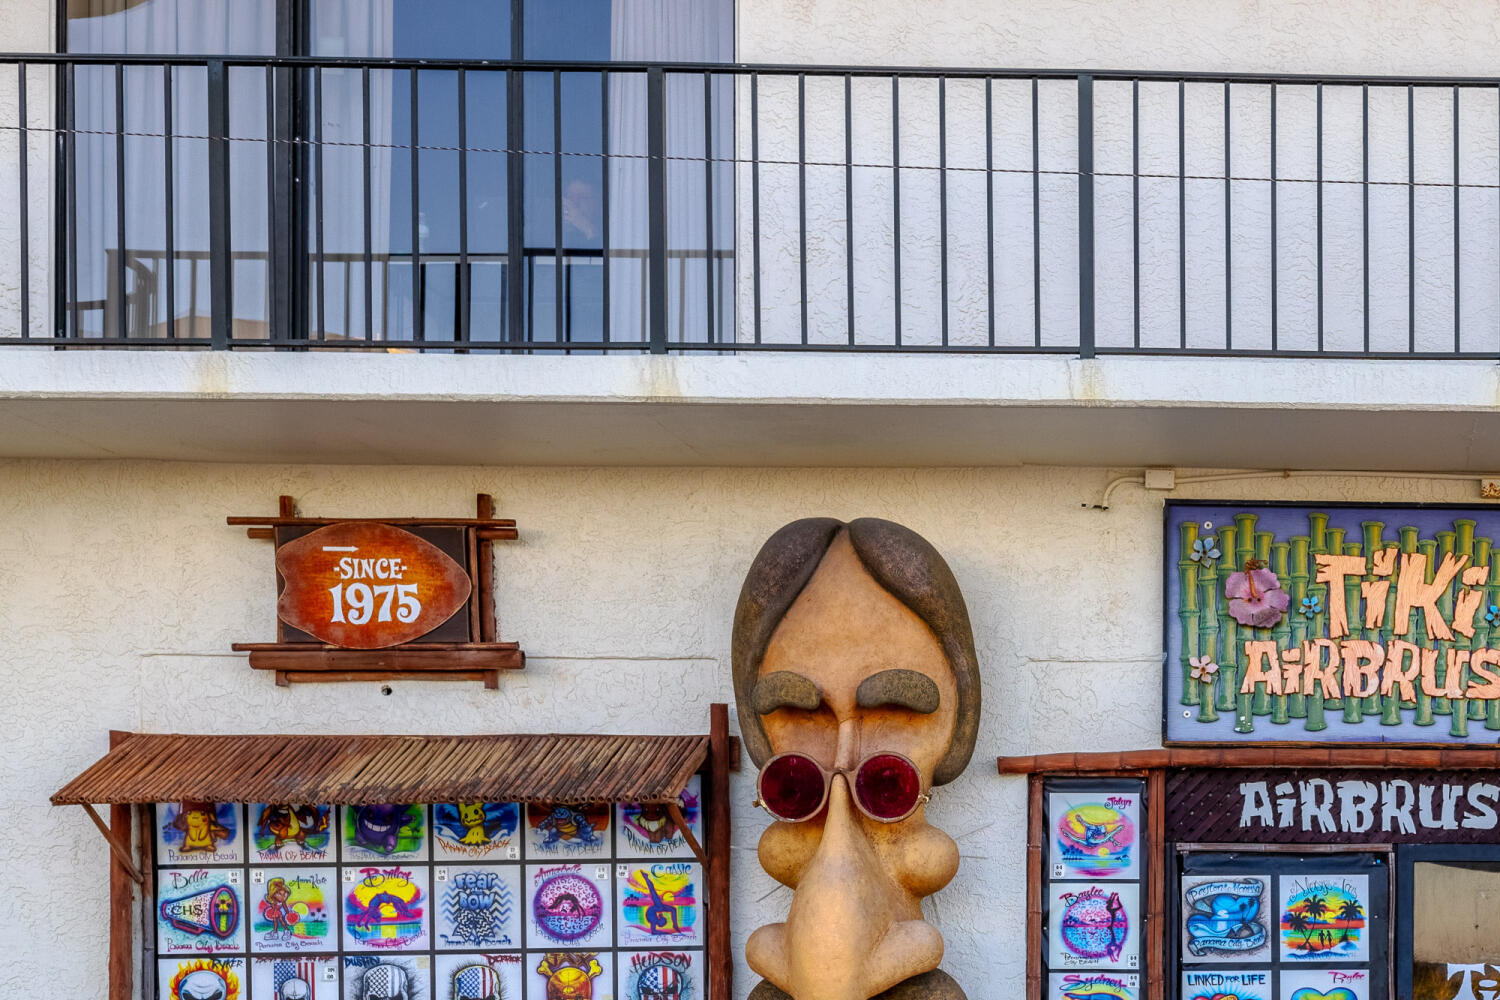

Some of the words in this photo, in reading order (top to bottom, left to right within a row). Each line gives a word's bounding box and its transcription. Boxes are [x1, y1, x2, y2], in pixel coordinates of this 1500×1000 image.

[328, 582, 421, 624] 1975
[168, 849, 198, 862] Panama
[213, 850, 237, 862] Beach
[455, 872, 498, 889] Fear
[1059, 974, 1127, 992] Sydney
